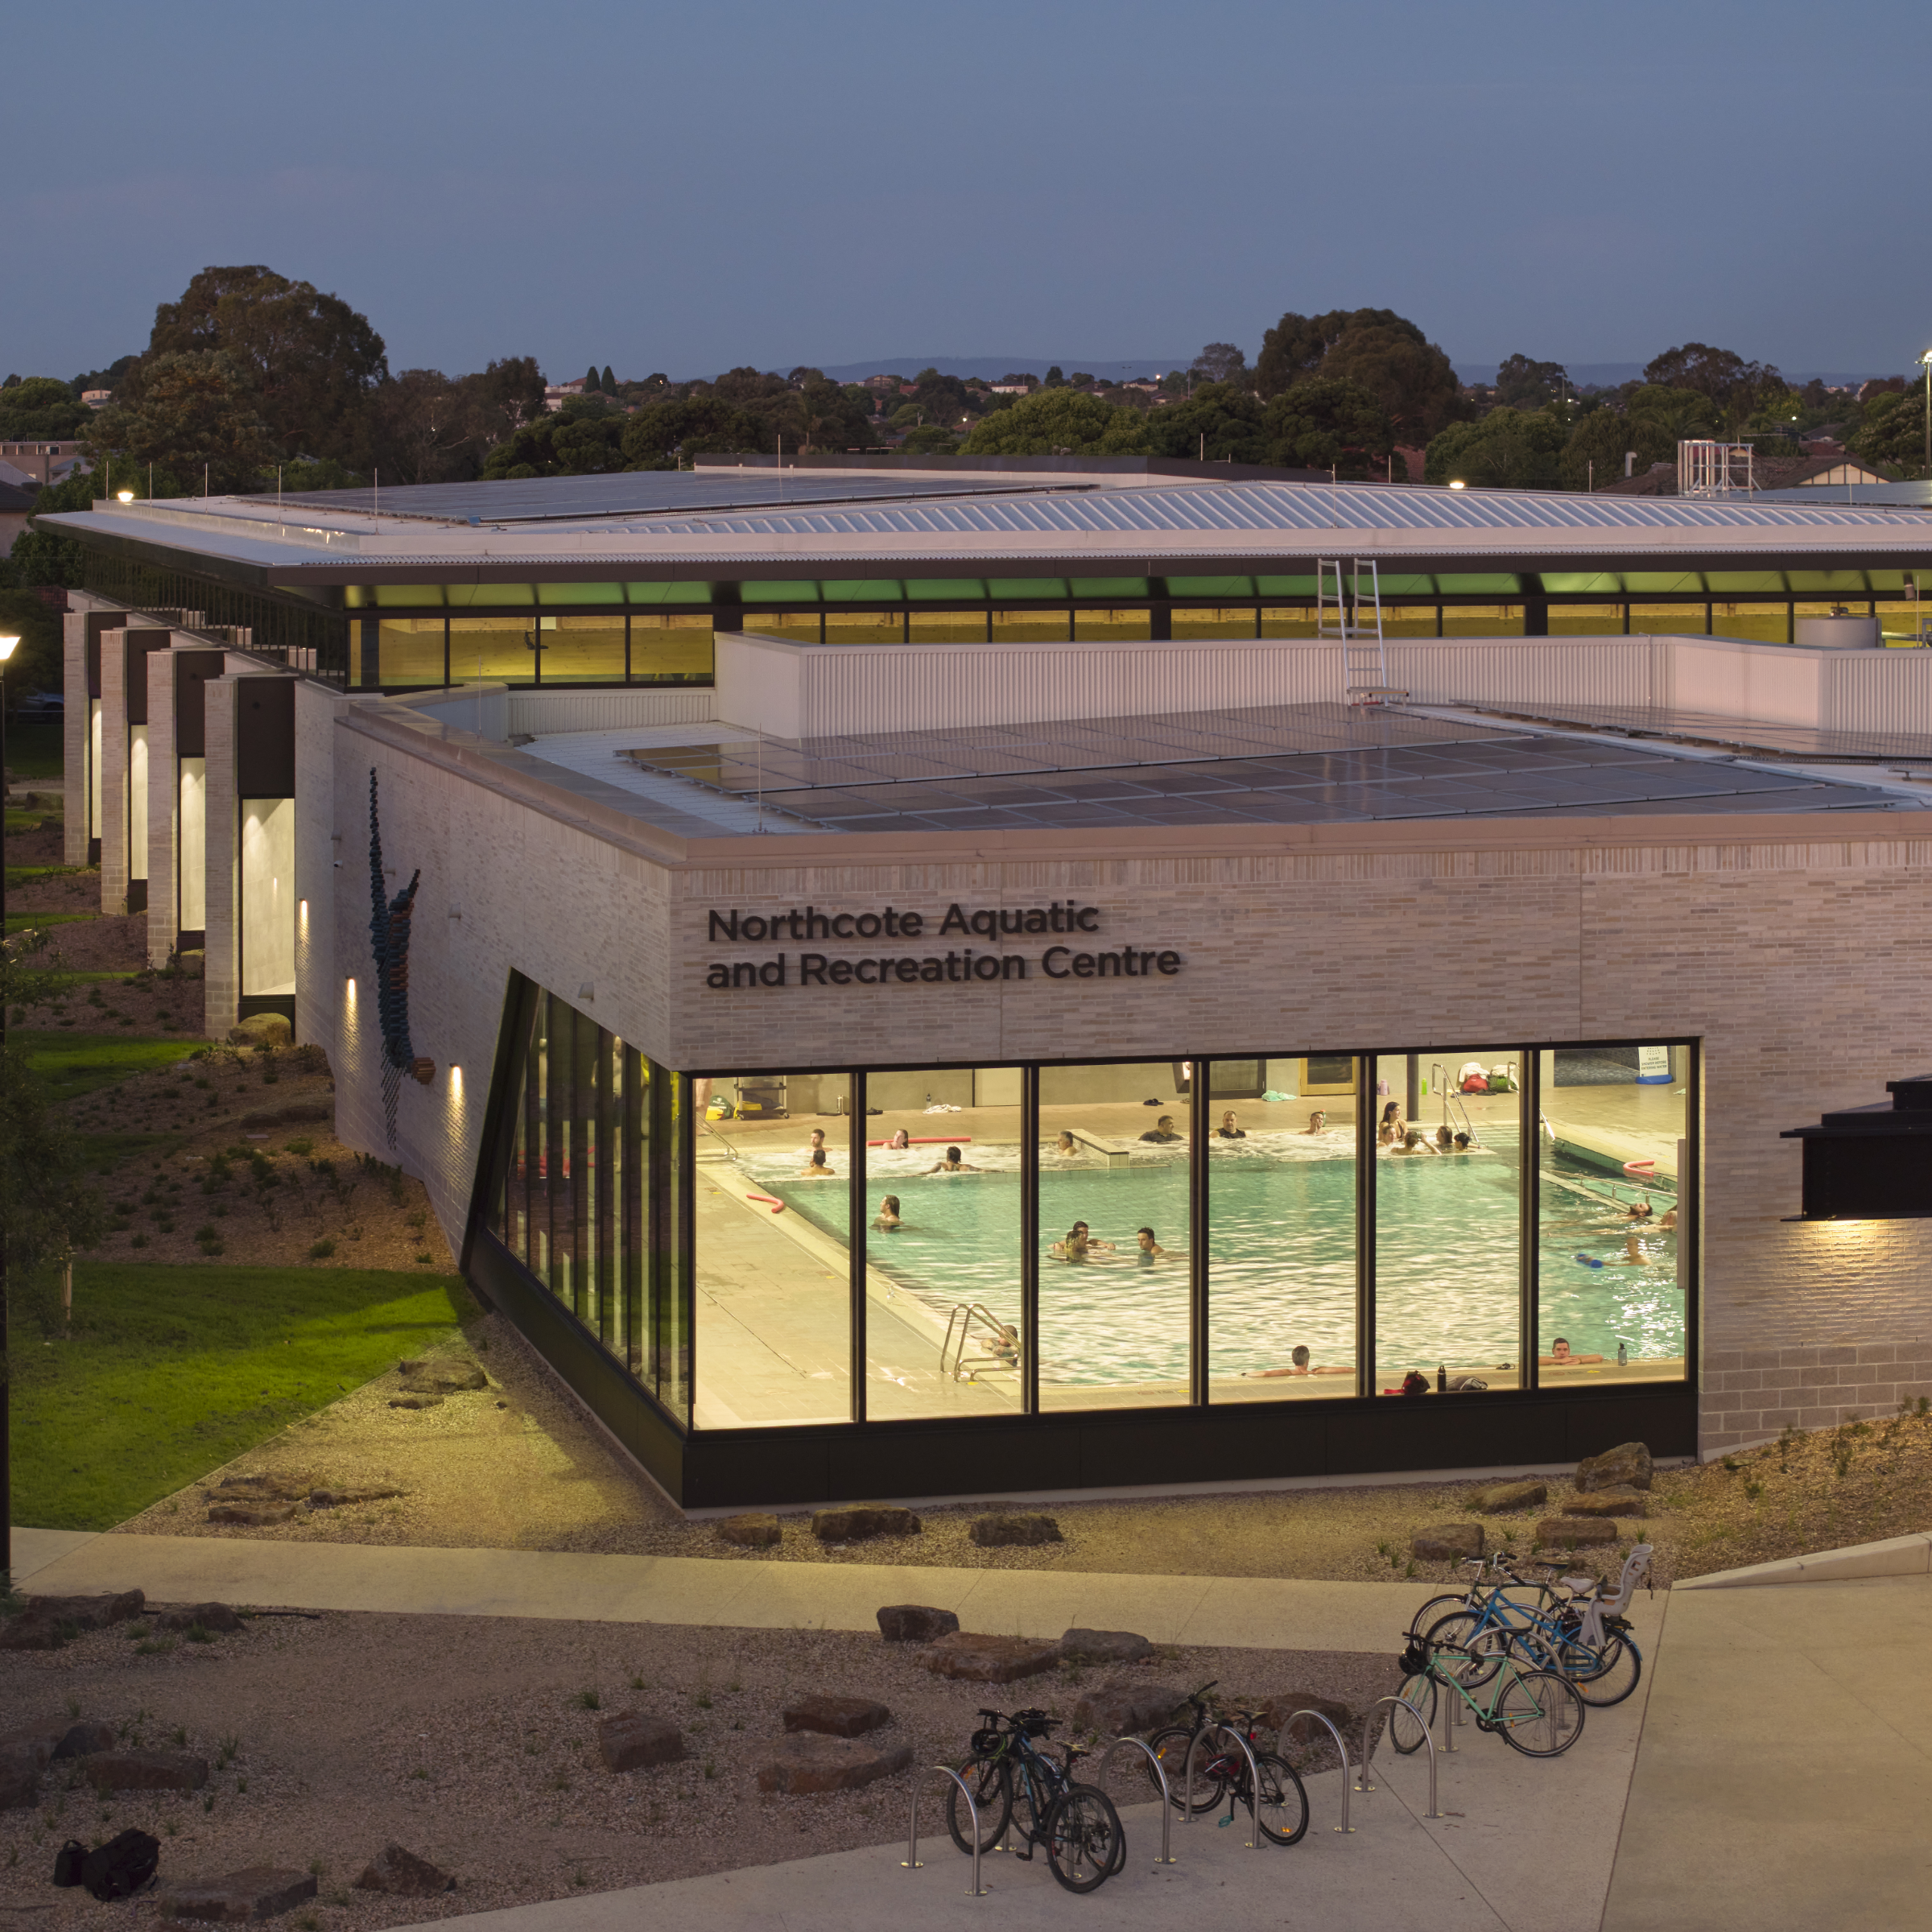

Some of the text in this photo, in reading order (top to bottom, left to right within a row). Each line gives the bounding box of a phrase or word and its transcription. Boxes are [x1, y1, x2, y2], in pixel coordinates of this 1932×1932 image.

[708, 899, 1100, 942] Northcote Aquatic
[707, 945, 1181, 989] and Recreation Centre
